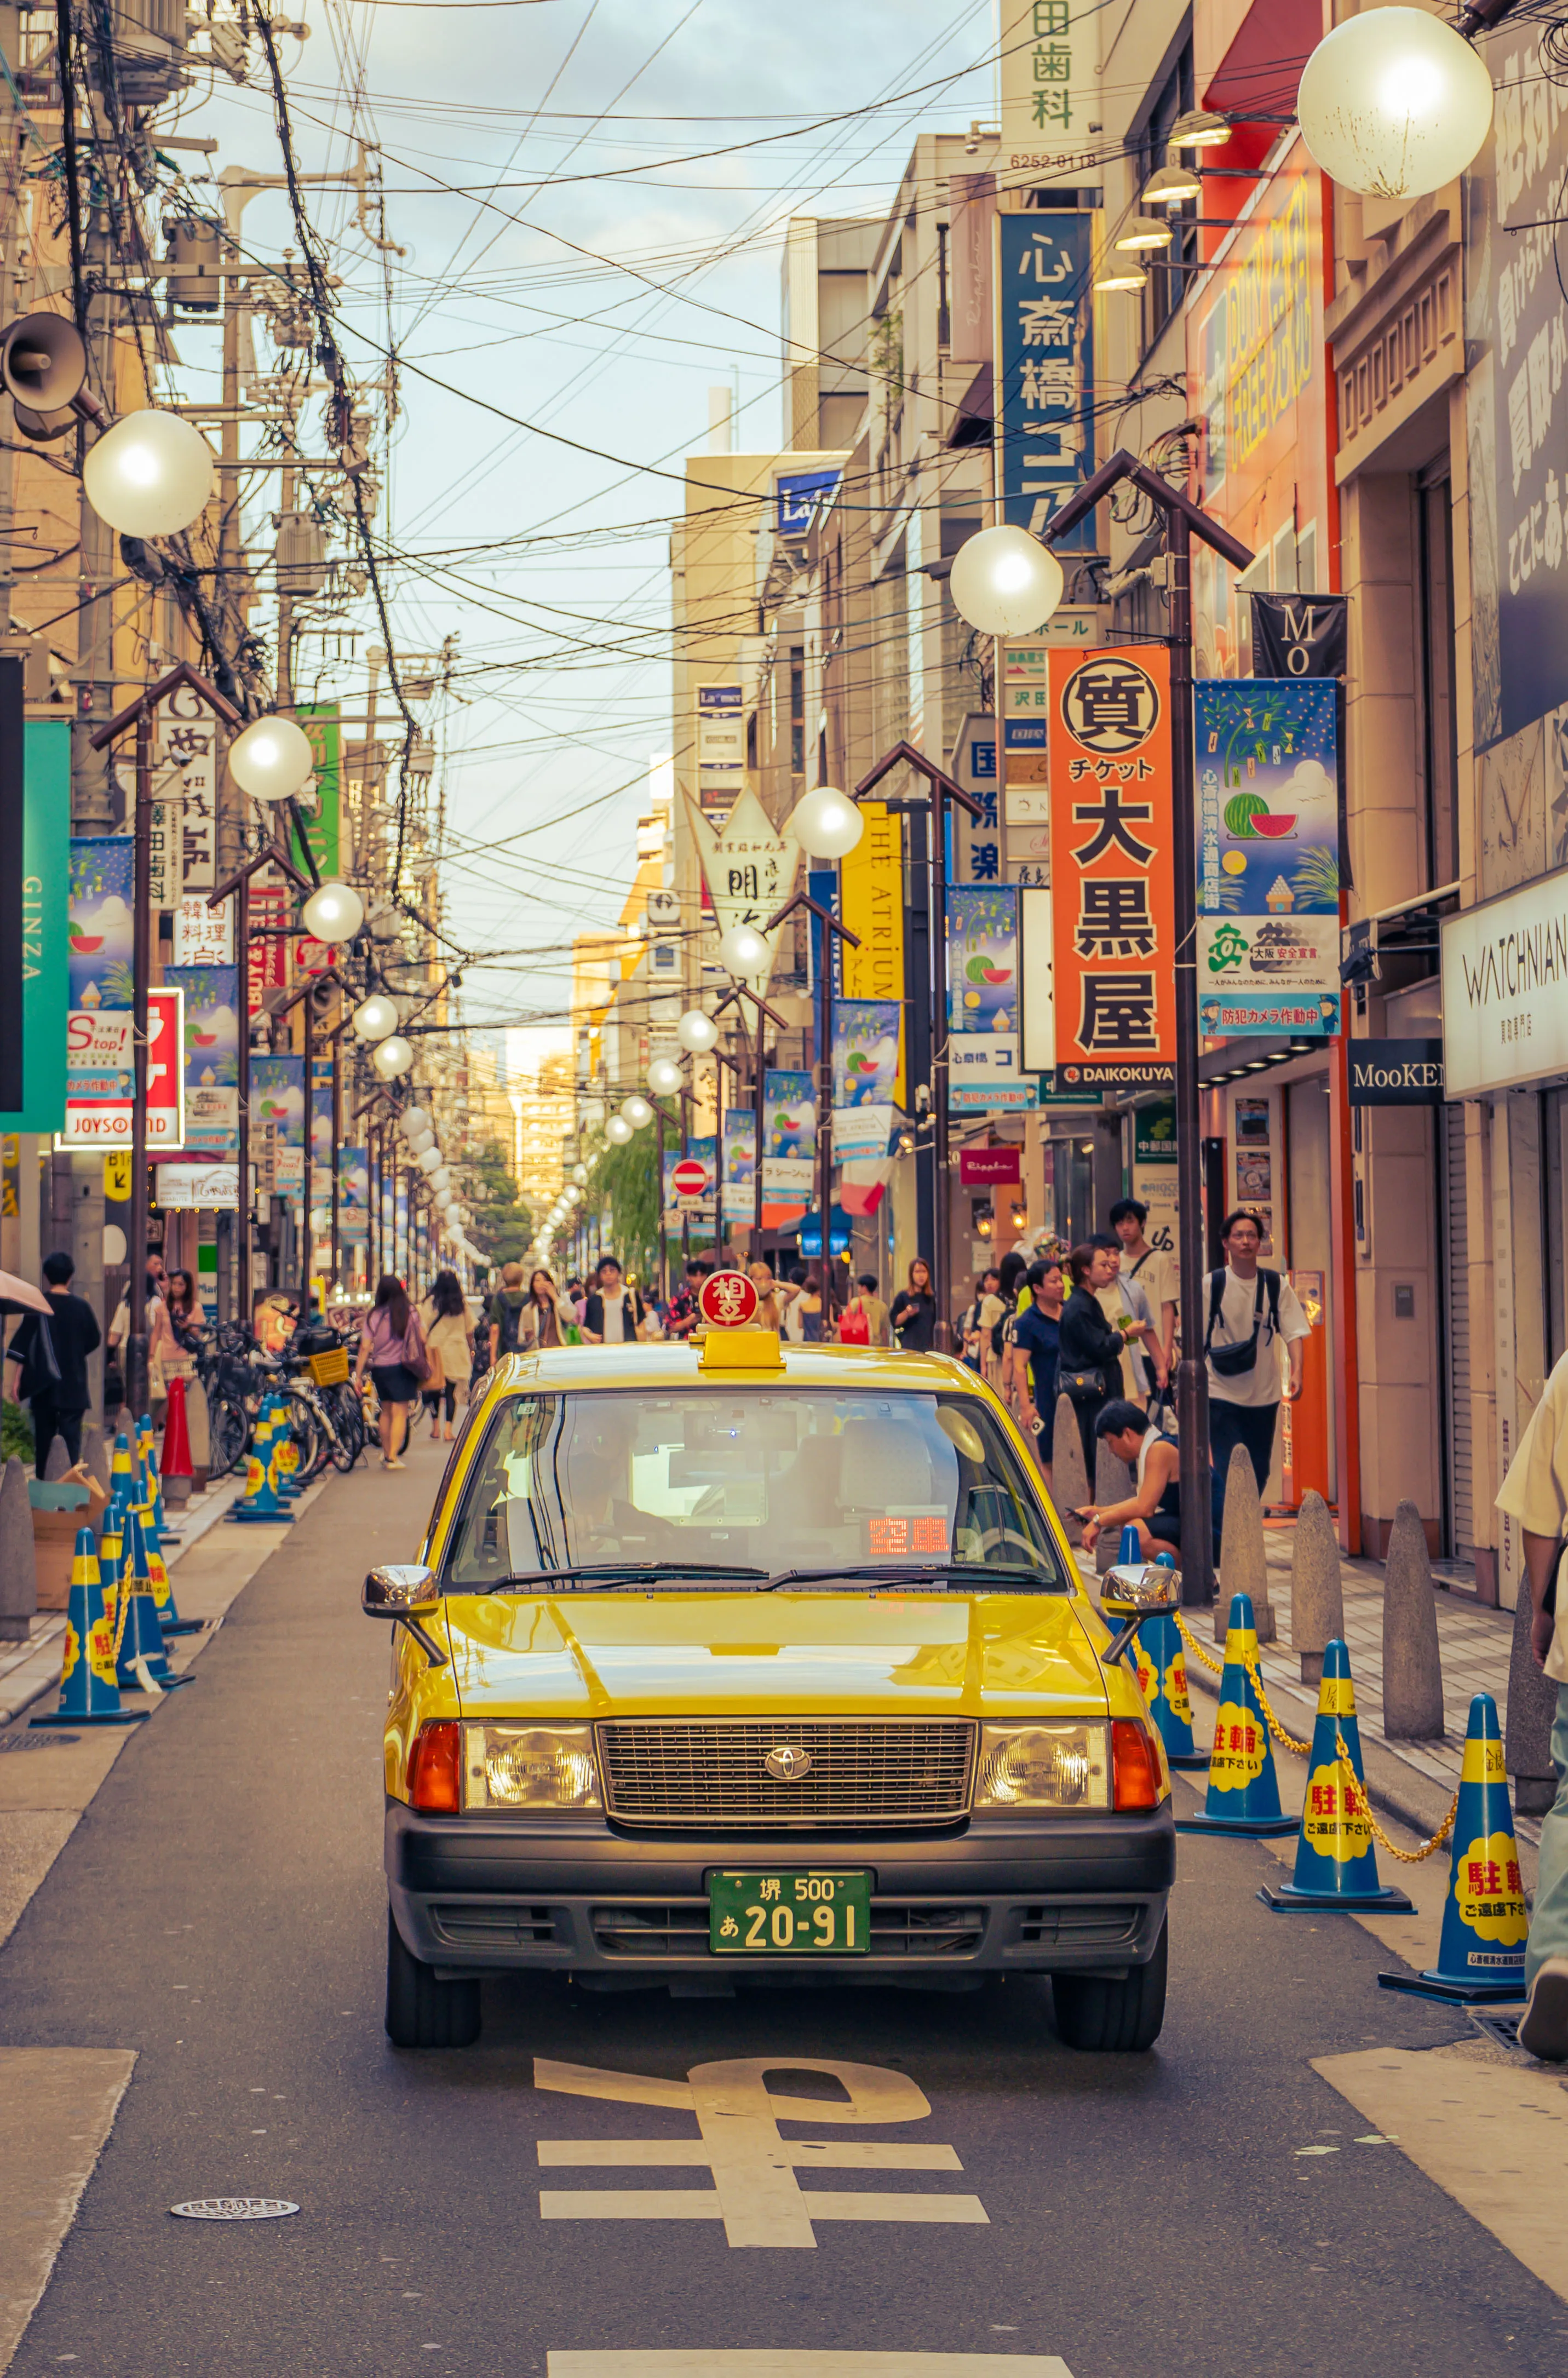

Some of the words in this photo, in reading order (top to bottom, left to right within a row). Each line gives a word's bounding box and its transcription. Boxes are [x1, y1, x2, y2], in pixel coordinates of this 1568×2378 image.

[1031, 0, 1073, 130] 田歯科
[1228, 232, 1265, 374] DUTY
[1231, 342, 1267, 473] FREE
[1076, 673, 1145, 744] 質
[1069, 759, 1154, 781] チケット
[870, 815, 891, 869] THE
[22, 875, 42, 979] GINZA
[182, 924, 227, 942] 料理
[1070, 786, 1160, 1054] 大黒屋
[1254, 947, 1274, 959] 大阪
[1277, 947, 1317, 959] 安全宣言
[1222, 1008, 1318, 1025] 防犯カメラ作動中
[1083, 1067, 1174, 1083] DAIKOKUYA
[1151, 1225, 1174, 1251] UP
[713, 1277, 746, 1322] 相互
[870, 1517, 949, 1554] 空車
[760, 1879, 781, 1900] 堺
[795, 1879, 834, 1901] 500
[720, 1916, 739, 1937] あ
[745, 1905, 854, 1947] 20-91
